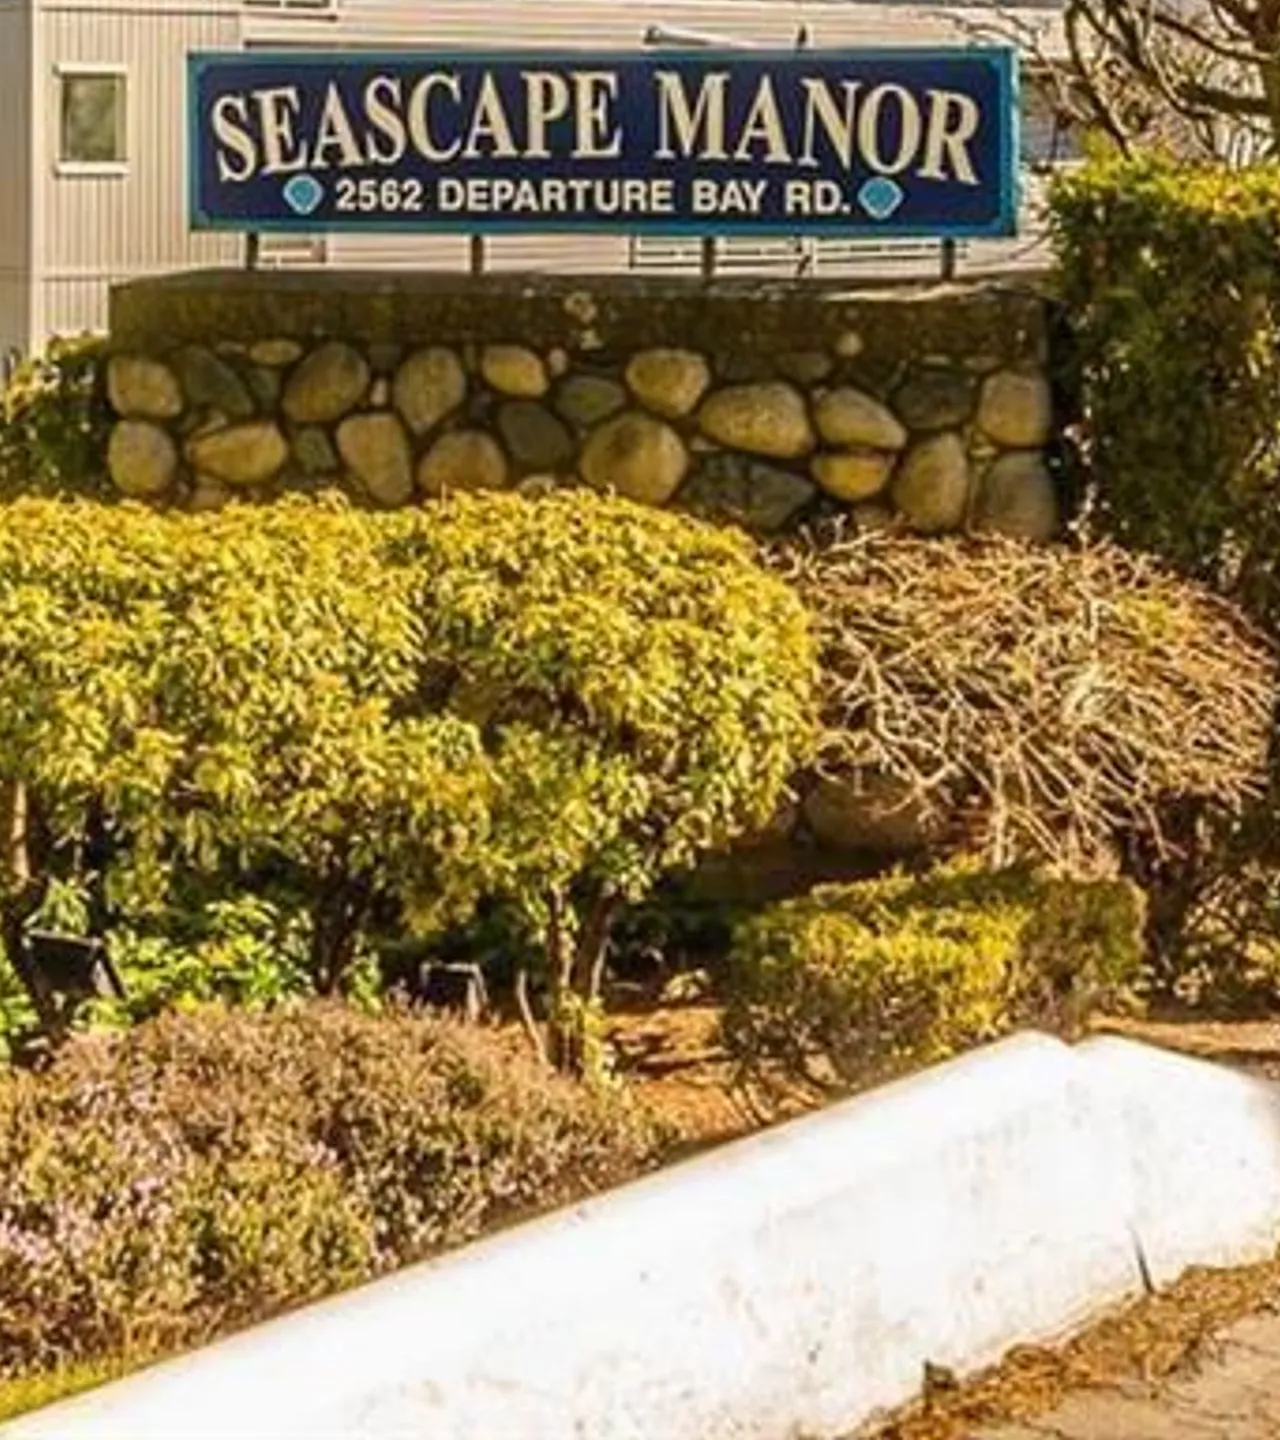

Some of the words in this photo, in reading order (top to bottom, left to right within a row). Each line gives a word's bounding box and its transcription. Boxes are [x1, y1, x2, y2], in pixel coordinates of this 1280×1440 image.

[211, 71, 622, 182] SEASCAPE
[654, 71, 980, 186] MANOR
[335, 178, 423, 212] 2562
[437, 179, 674, 213] DEPARTURE
[692, 179, 767, 213] BAY
[784, 180, 851, 215] RD.
